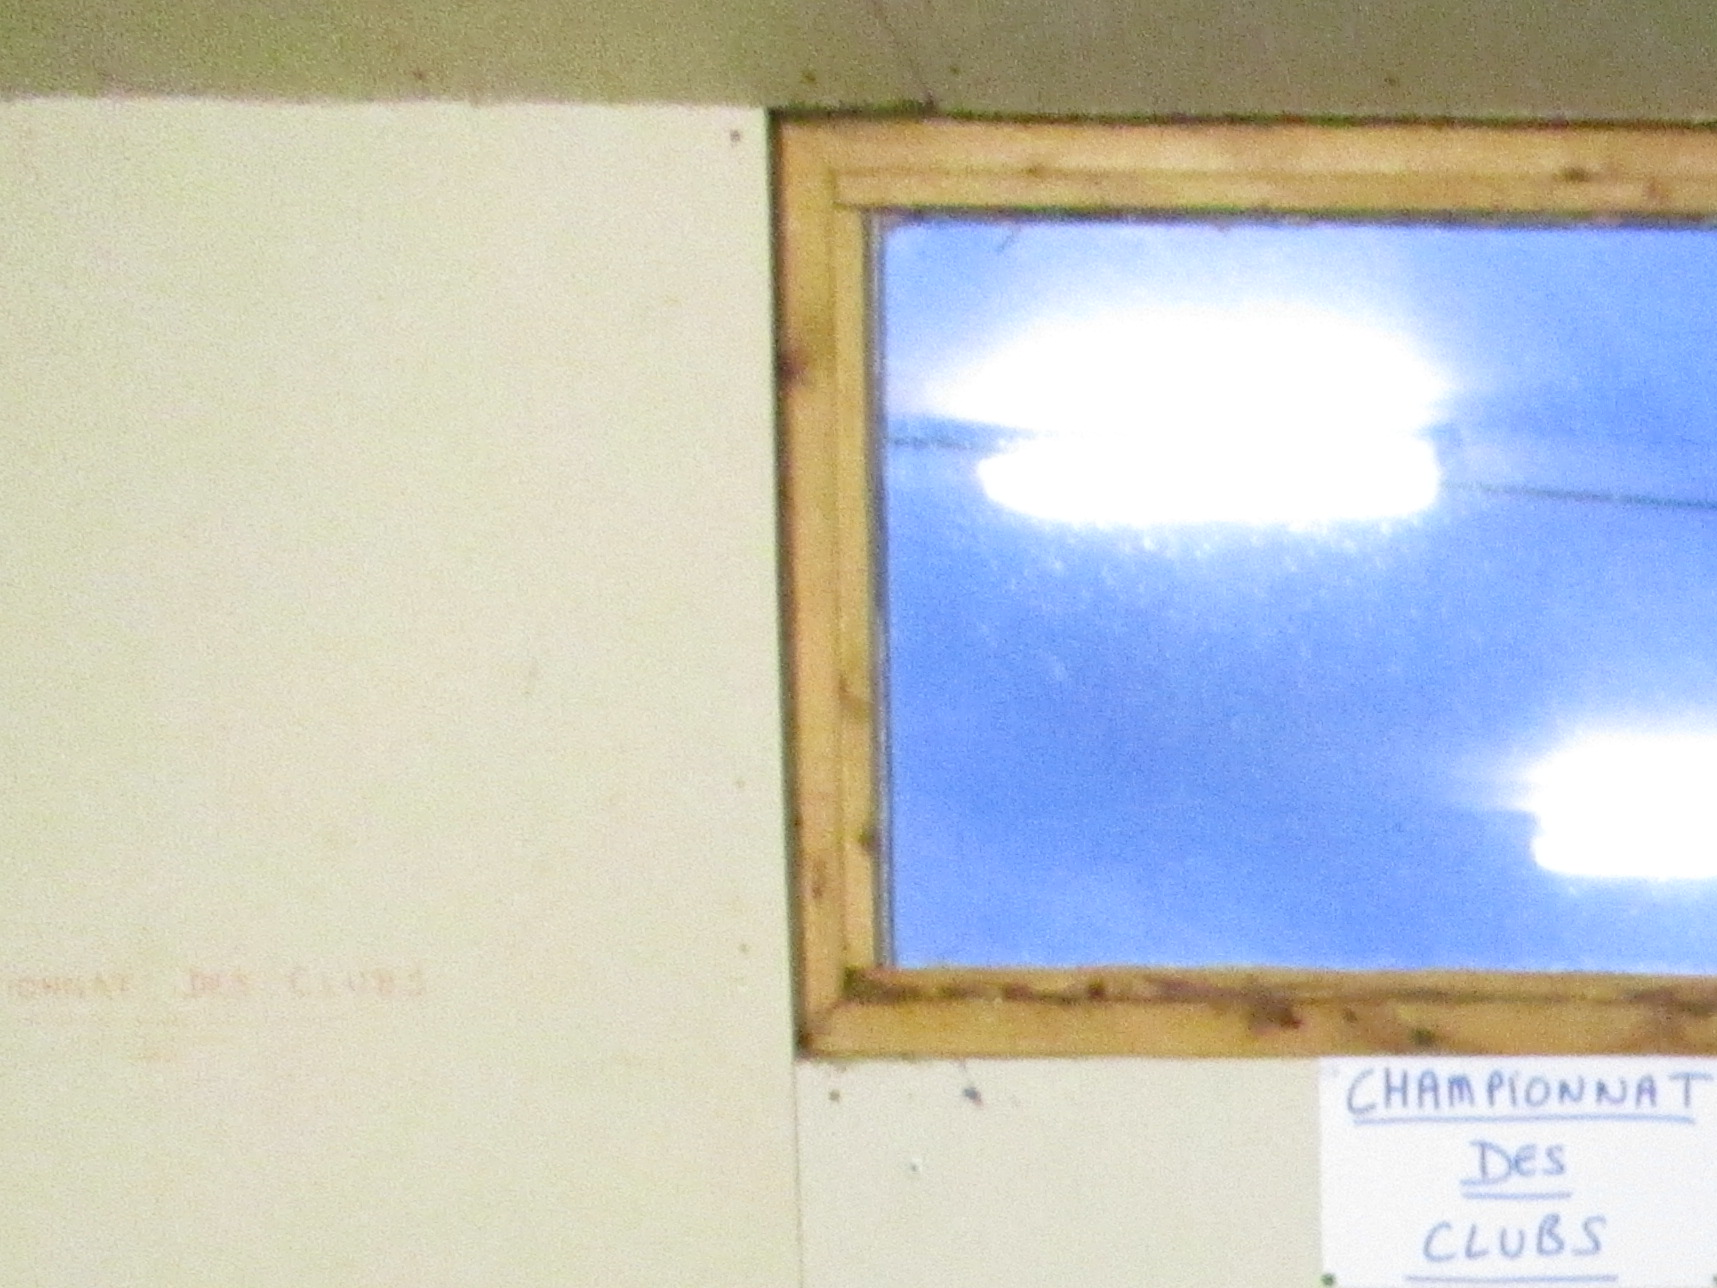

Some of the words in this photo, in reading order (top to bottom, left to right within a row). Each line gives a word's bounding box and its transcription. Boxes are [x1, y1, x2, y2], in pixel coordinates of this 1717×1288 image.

[1347, 1067, 1713, 1115] CHAMPIONNAT
[1460, 1138, 1567, 1186] DES
[1422, 1212, 1607, 1262] CLUBS
